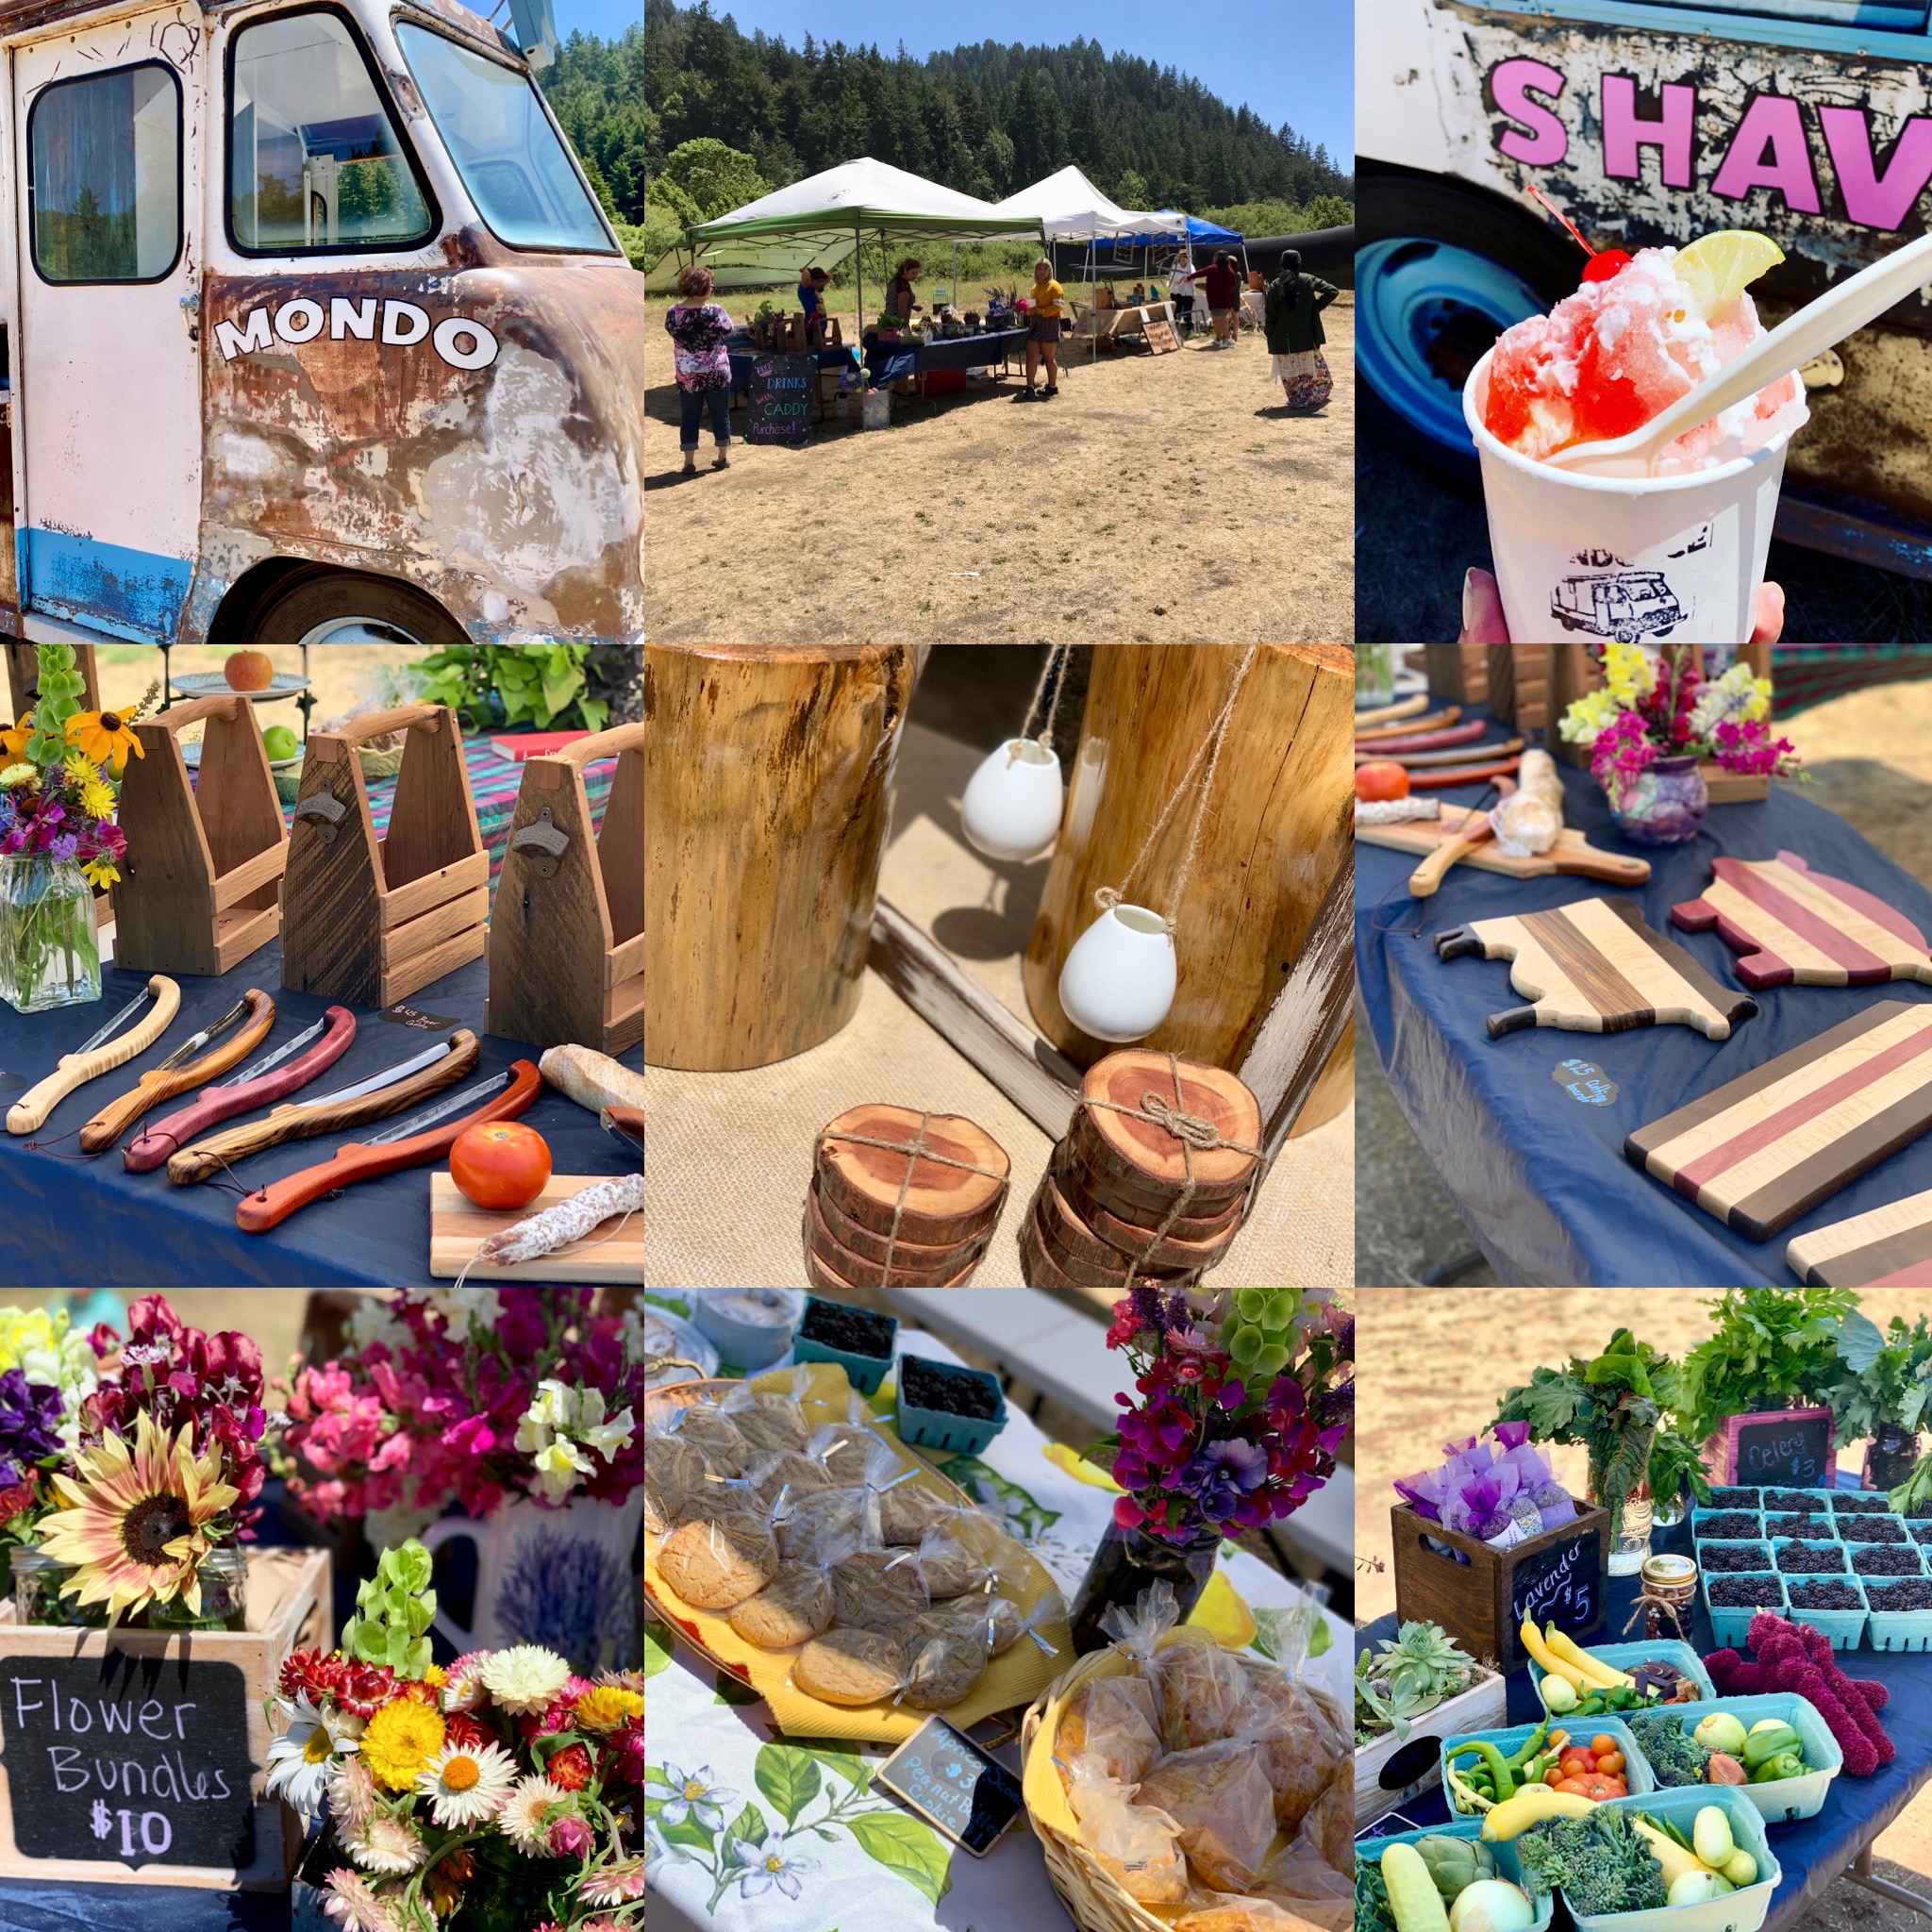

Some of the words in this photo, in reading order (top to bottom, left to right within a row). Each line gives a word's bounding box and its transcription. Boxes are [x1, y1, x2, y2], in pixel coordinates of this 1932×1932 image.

[1488, 58, 1932, 232] SHAV
[214, 296, 499, 371] MONDO
[767, 377, 807, 389] DRINKS
[764, 403, 808, 415] CADDY
[1749, 1431, 1807, 1471] Celery
[1790, 1457, 1816, 1478] $3
[1514, 1541, 1581, 1620] Lavender
[1564, 1584, 1591, 1623] $5
[10, 1676, 196, 1740] Flower
[930, 1728, 991, 1773] Apricot
[47, 1746, 231, 1803] Bundles
[903, 1756, 959, 1805] Peanut
[945, 1762, 976, 1789] $3
[90, 1798, 173, 1857] $10
[908, 1784, 957, 1828] Cookie
